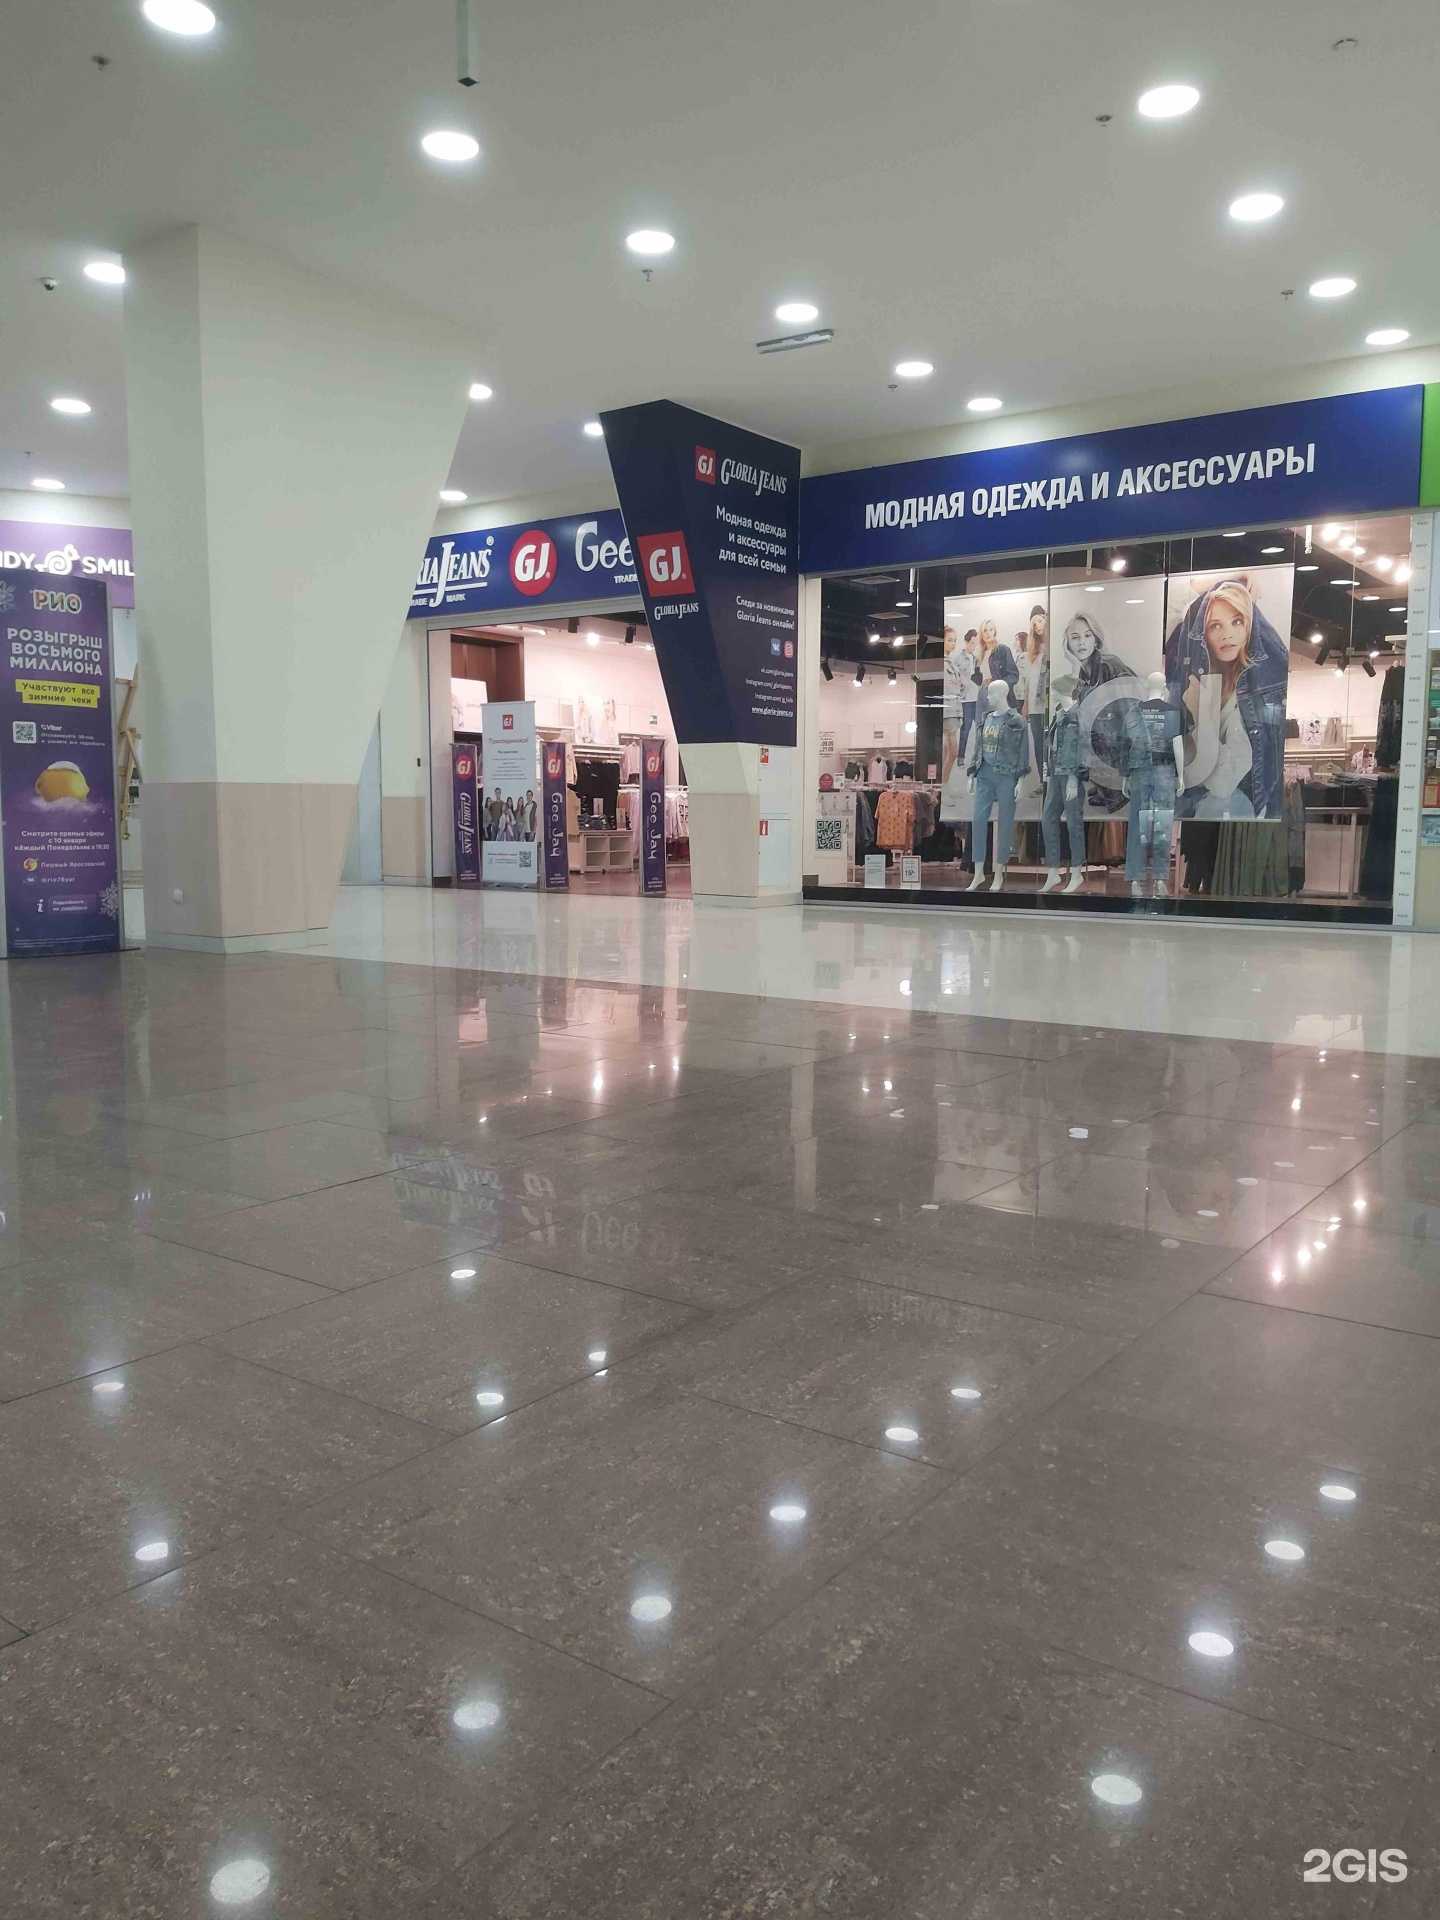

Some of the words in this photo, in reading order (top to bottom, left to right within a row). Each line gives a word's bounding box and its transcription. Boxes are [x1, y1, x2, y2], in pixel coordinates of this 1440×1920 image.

[697, 455, 714, 475] GJ
[720, 458, 757, 485] GLORIA
[755, 470, 787, 496] JEANS
[865, 491, 964, 529] МОДНАЯ
[972, 475, 1084, 517] ОДЕЖДА
[1092, 473, 1110, 500] И
[1117, 443, 1316, 496] АКСЕССУАРЫ
[716, 505, 752, 529] Модная
[754, 520, 787, 538] одежда
[575, 520, 634, 572] Gee
[728, 532, 735, 542] и
[736, 534, 787, 557] аксессуары
[0, 551, 36, 569] DY
[514, 542, 550, 582] GJ
[649, 546, 682, 582] GJ
[719, 548, 736, 562] для
[738, 553, 759, 567] всей
[761, 559, 787, 574] семьи
[429, 541, 492, 608] JEANS
[32, 589, 82, 614] РИО
[654, 604, 679, 620] GLORIA
[678, 602, 699, 619] JEANS
[737, 610, 756, 622] Gloria
[7, 627, 103, 648] РОЗЫГРЫШ
[11, 642, 101, 662] ВОСЬМОГО
[9, 656, 103, 676] МИЛЛИОНА
[457, 761, 472, 775] GJ
[551, 792, 563, 823] Gee
[650, 792, 661, 824] Gee
